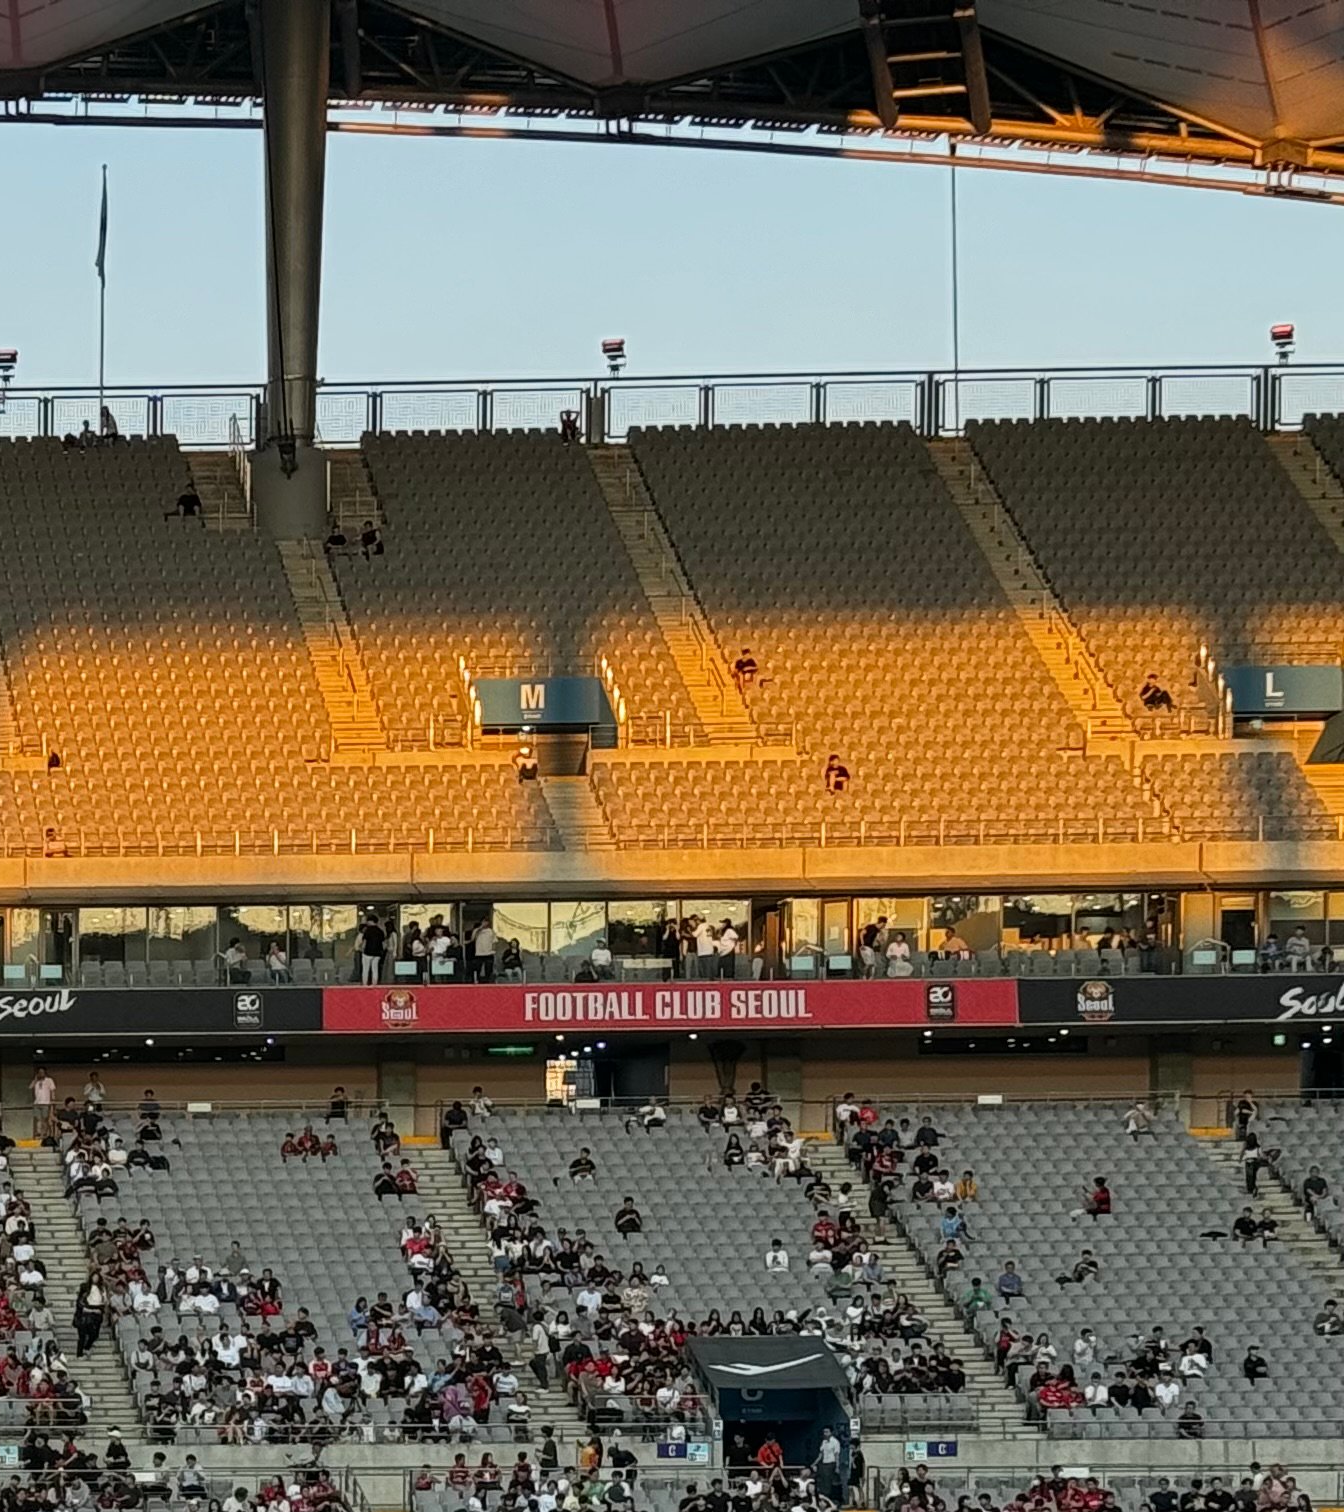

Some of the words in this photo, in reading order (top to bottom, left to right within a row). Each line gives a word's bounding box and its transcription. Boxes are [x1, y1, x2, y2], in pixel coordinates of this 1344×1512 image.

[520, 684, 545, 709] M
[1265, 672, 1284, 697] L
[524, 991, 650, 1021] FOOTBALL
[655, 990, 721, 1020] CLUB
[730, 989, 812, 1020] SEOUL
